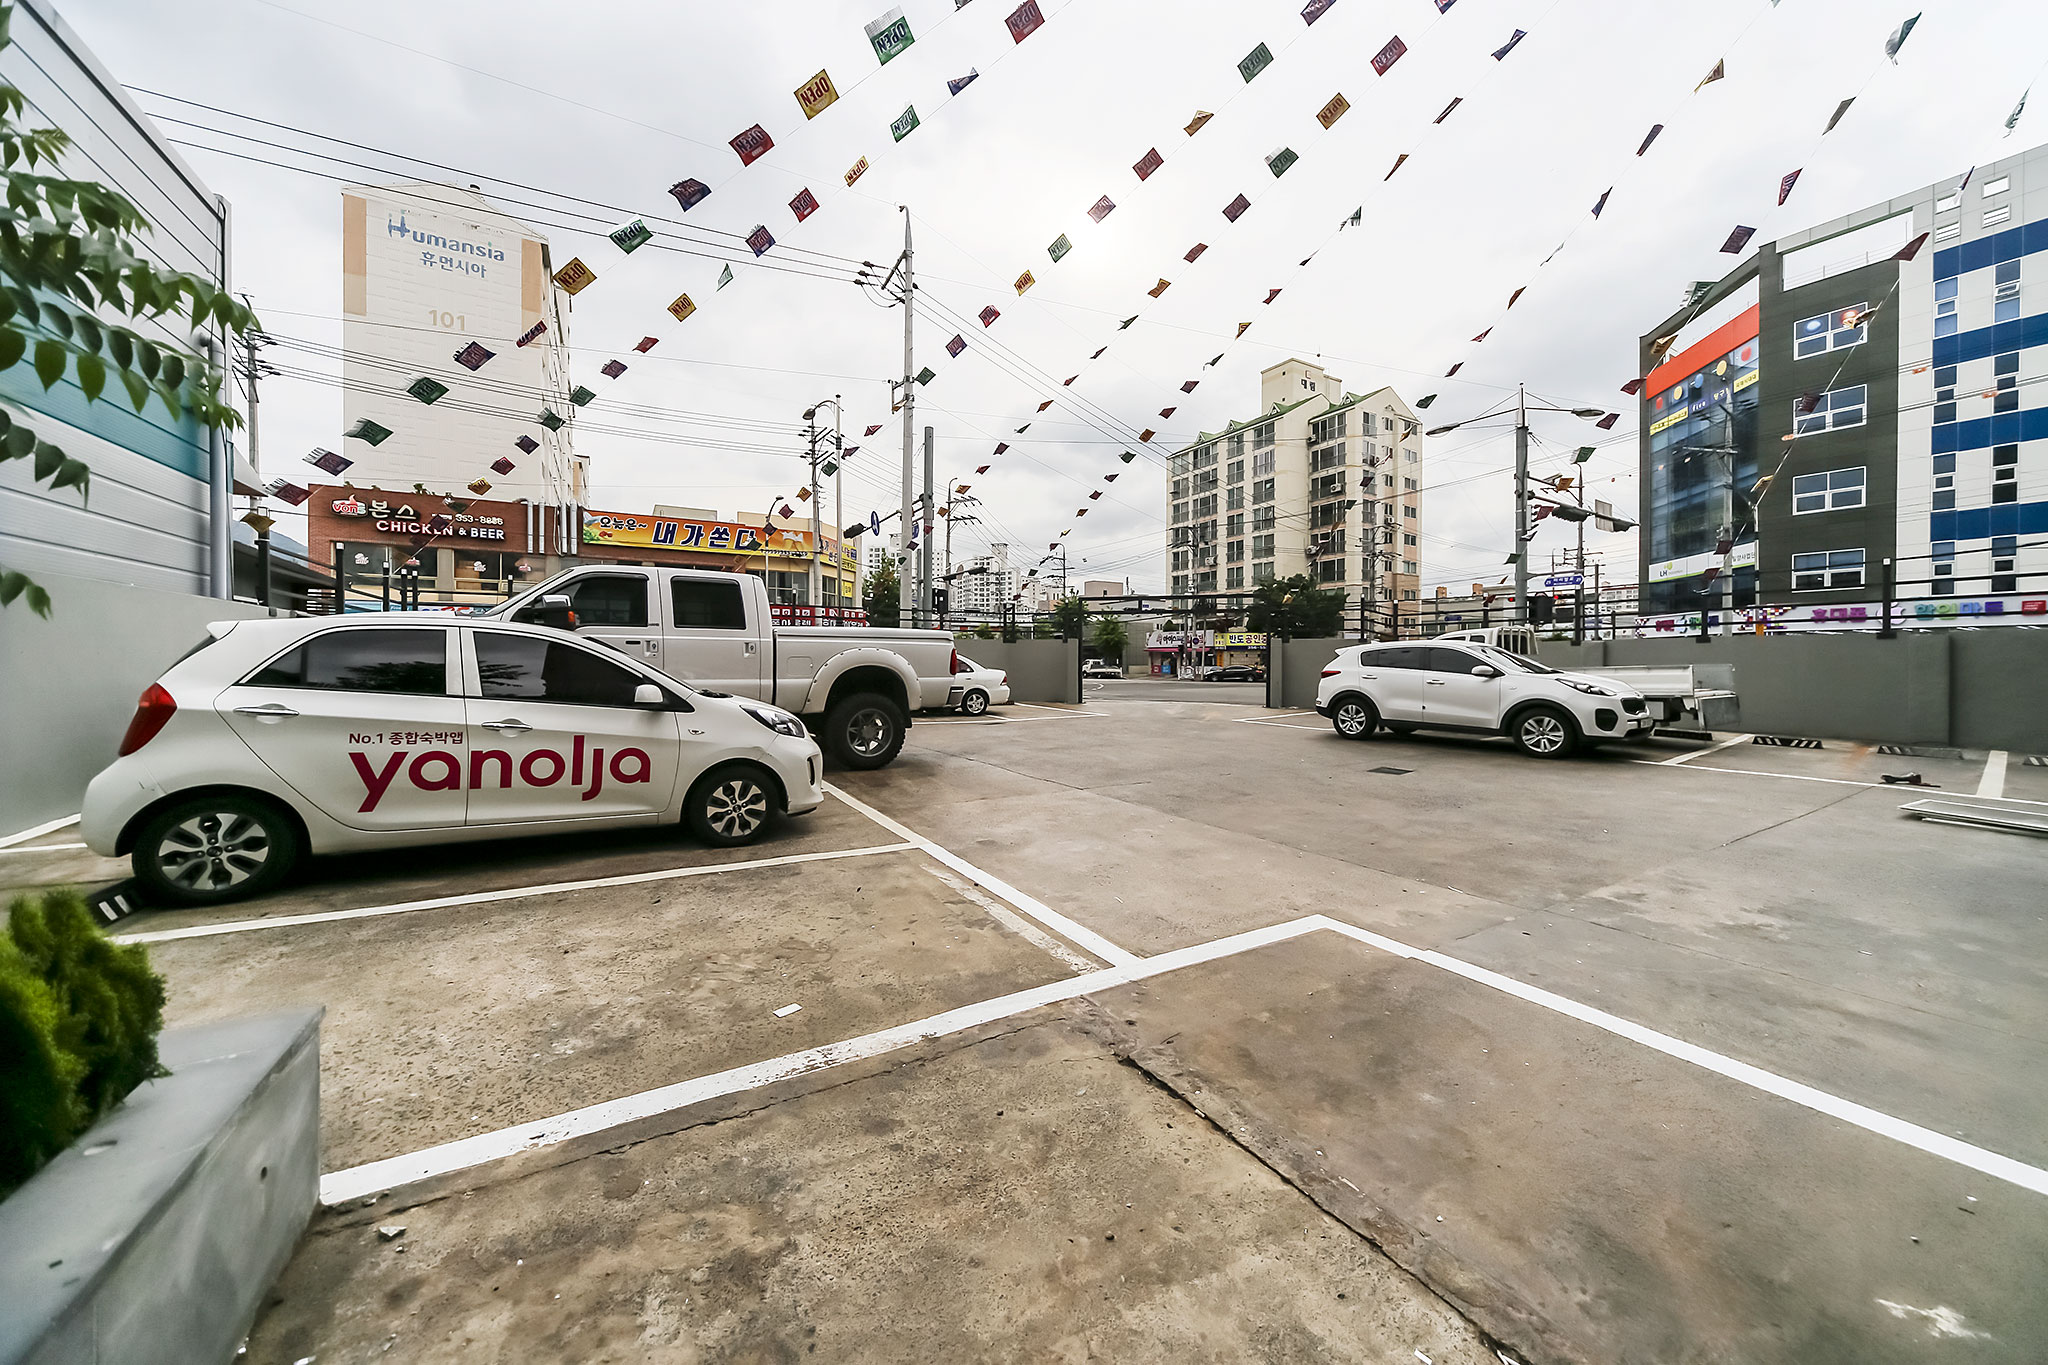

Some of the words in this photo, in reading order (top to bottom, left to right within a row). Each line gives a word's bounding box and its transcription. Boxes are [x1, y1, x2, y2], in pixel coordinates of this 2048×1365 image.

[1010, 3, 1037, 34] OPEN
[875, 22, 907, 54] OPEN
[1242, 47, 1266, 75] OPEN
[799, 76, 831, 107] OPEN
[893, 109, 915, 134] OPEN
[1320, 96, 1345, 123] OPEN
[734, 128, 765, 155] OPEN
[847, 159, 867, 181] OPEN
[792, 192, 813, 214] OPEN
[387, 209, 505, 262] Humansia
[614, 223, 643, 246] OPEN
[419, 251, 488, 279] 휴먼시아
[558, 262, 587, 288] OPEN
[672, 297, 691, 316] OPEN
[428, 309, 467, 332] 101
[458, 527, 467, 536] &
[470, 527, 506, 540] BEER
[348, 732, 384, 746] No.1
[388, 731, 465, 746] 종합숙박앱
[348, 734, 652, 813] yanolja
